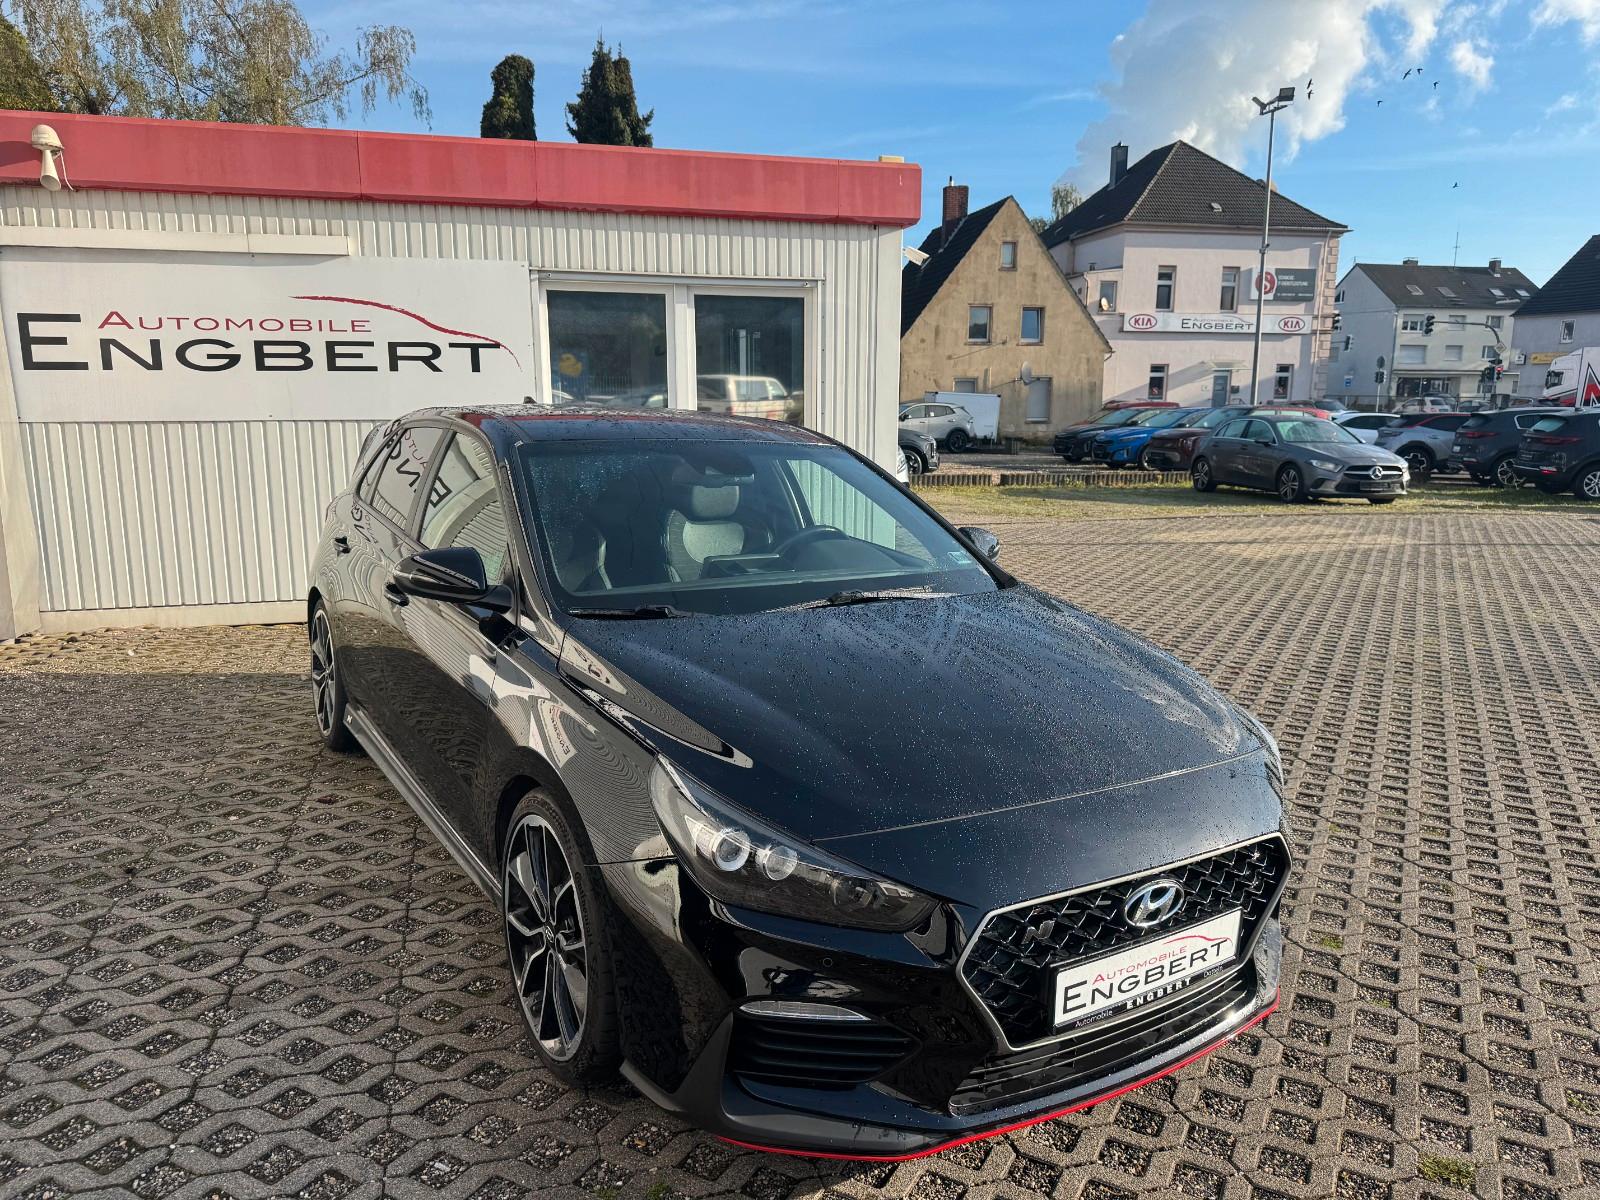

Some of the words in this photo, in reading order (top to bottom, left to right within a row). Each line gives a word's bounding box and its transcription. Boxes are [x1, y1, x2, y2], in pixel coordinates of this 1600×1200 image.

[97, 311, 372, 333] AUTOMOBILE
[1133, 317, 1153, 327] KIA
[1181, 318, 1254, 330] ENGBERT
[1282, 320, 1301, 329] KIA
[16, 312, 501, 373] ENGBERT
[1062, 938, 1229, 1015] ENGBERT
[1092, 945, 1188, 985] AUTOMOBILE
[1074, 1008, 1114, 1028] Automobile
[1126, 977, 1192, 1010] ENGBERT
